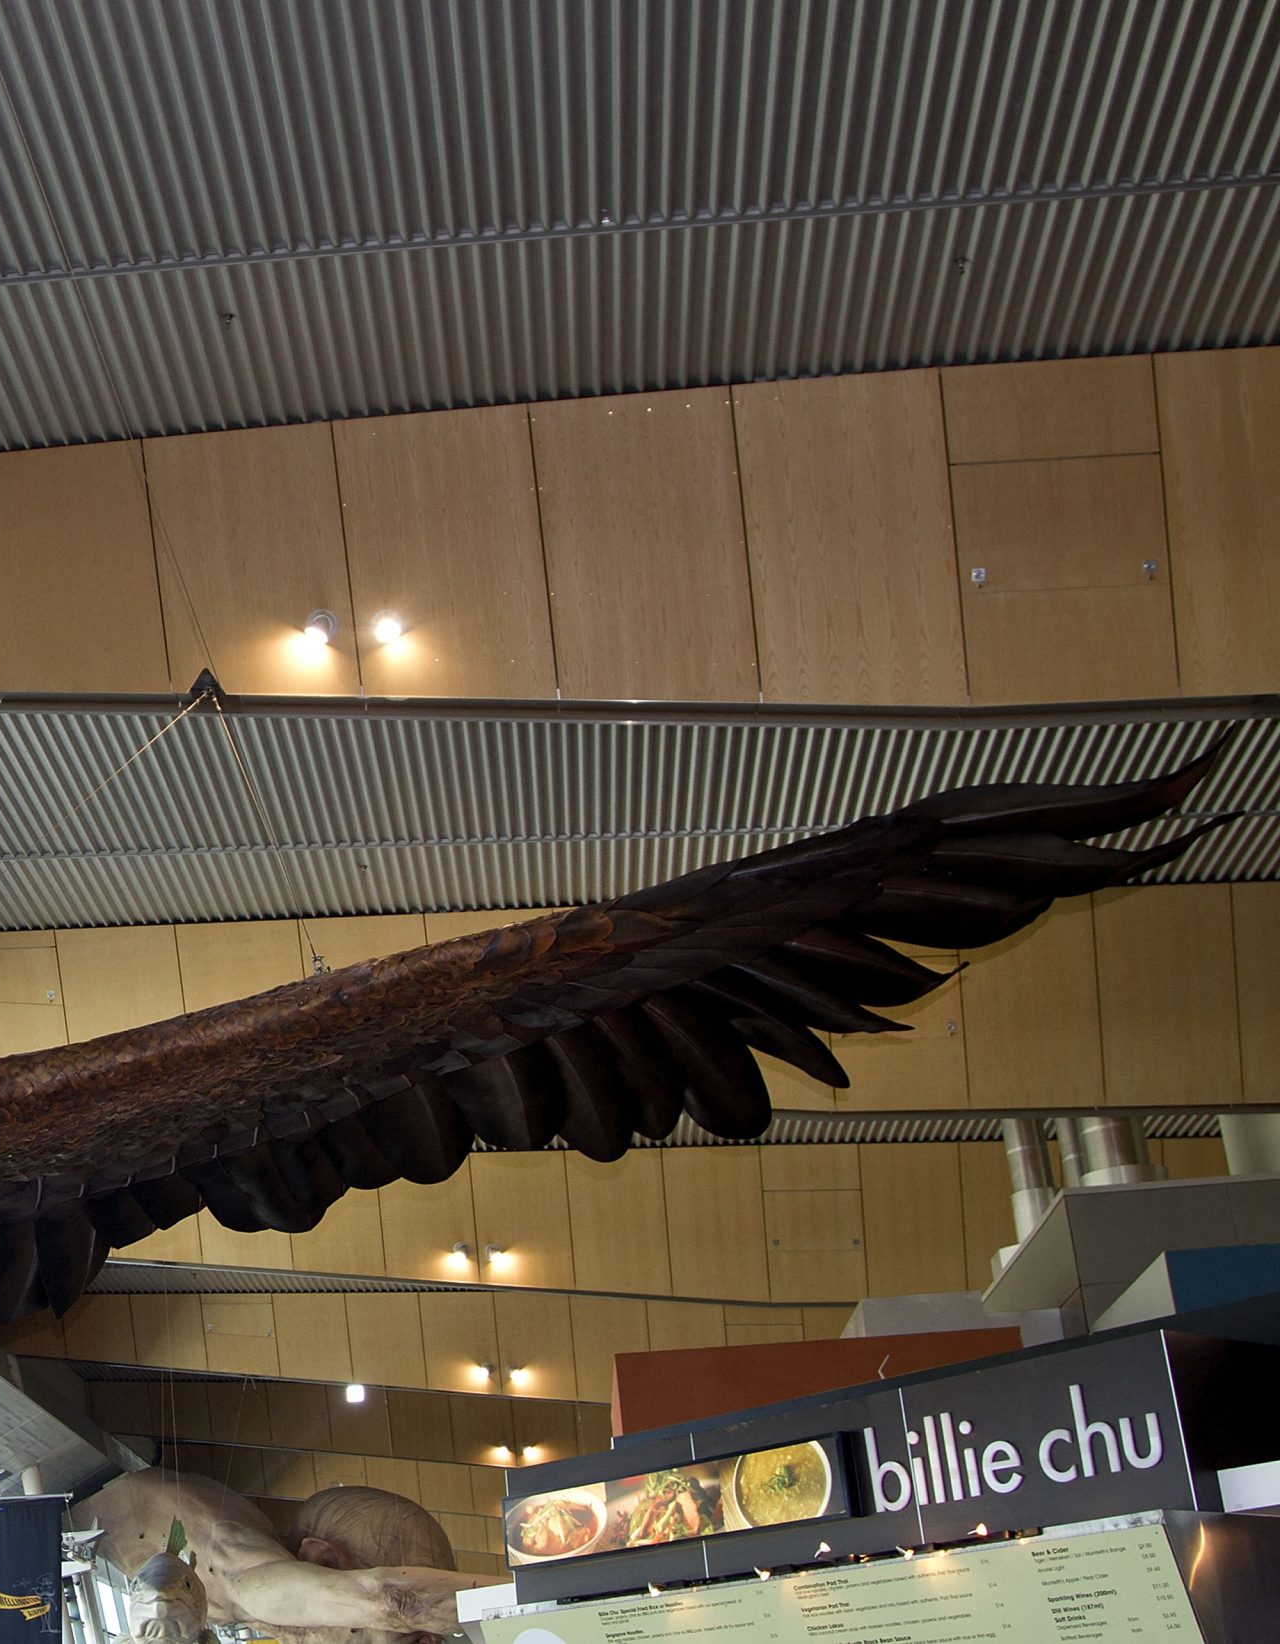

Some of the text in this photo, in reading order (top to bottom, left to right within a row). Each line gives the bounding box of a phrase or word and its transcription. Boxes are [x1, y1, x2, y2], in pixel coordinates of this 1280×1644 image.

[863, 1383, 1163, 1513] billie chu
[793, 1582, 826, 1591] Combination
[1047, 1595, 1075, 1603] Sparkling
[800, 1605, 828, 1613] Vegetarian
[605, 1631, 626, 1639] Singapore
